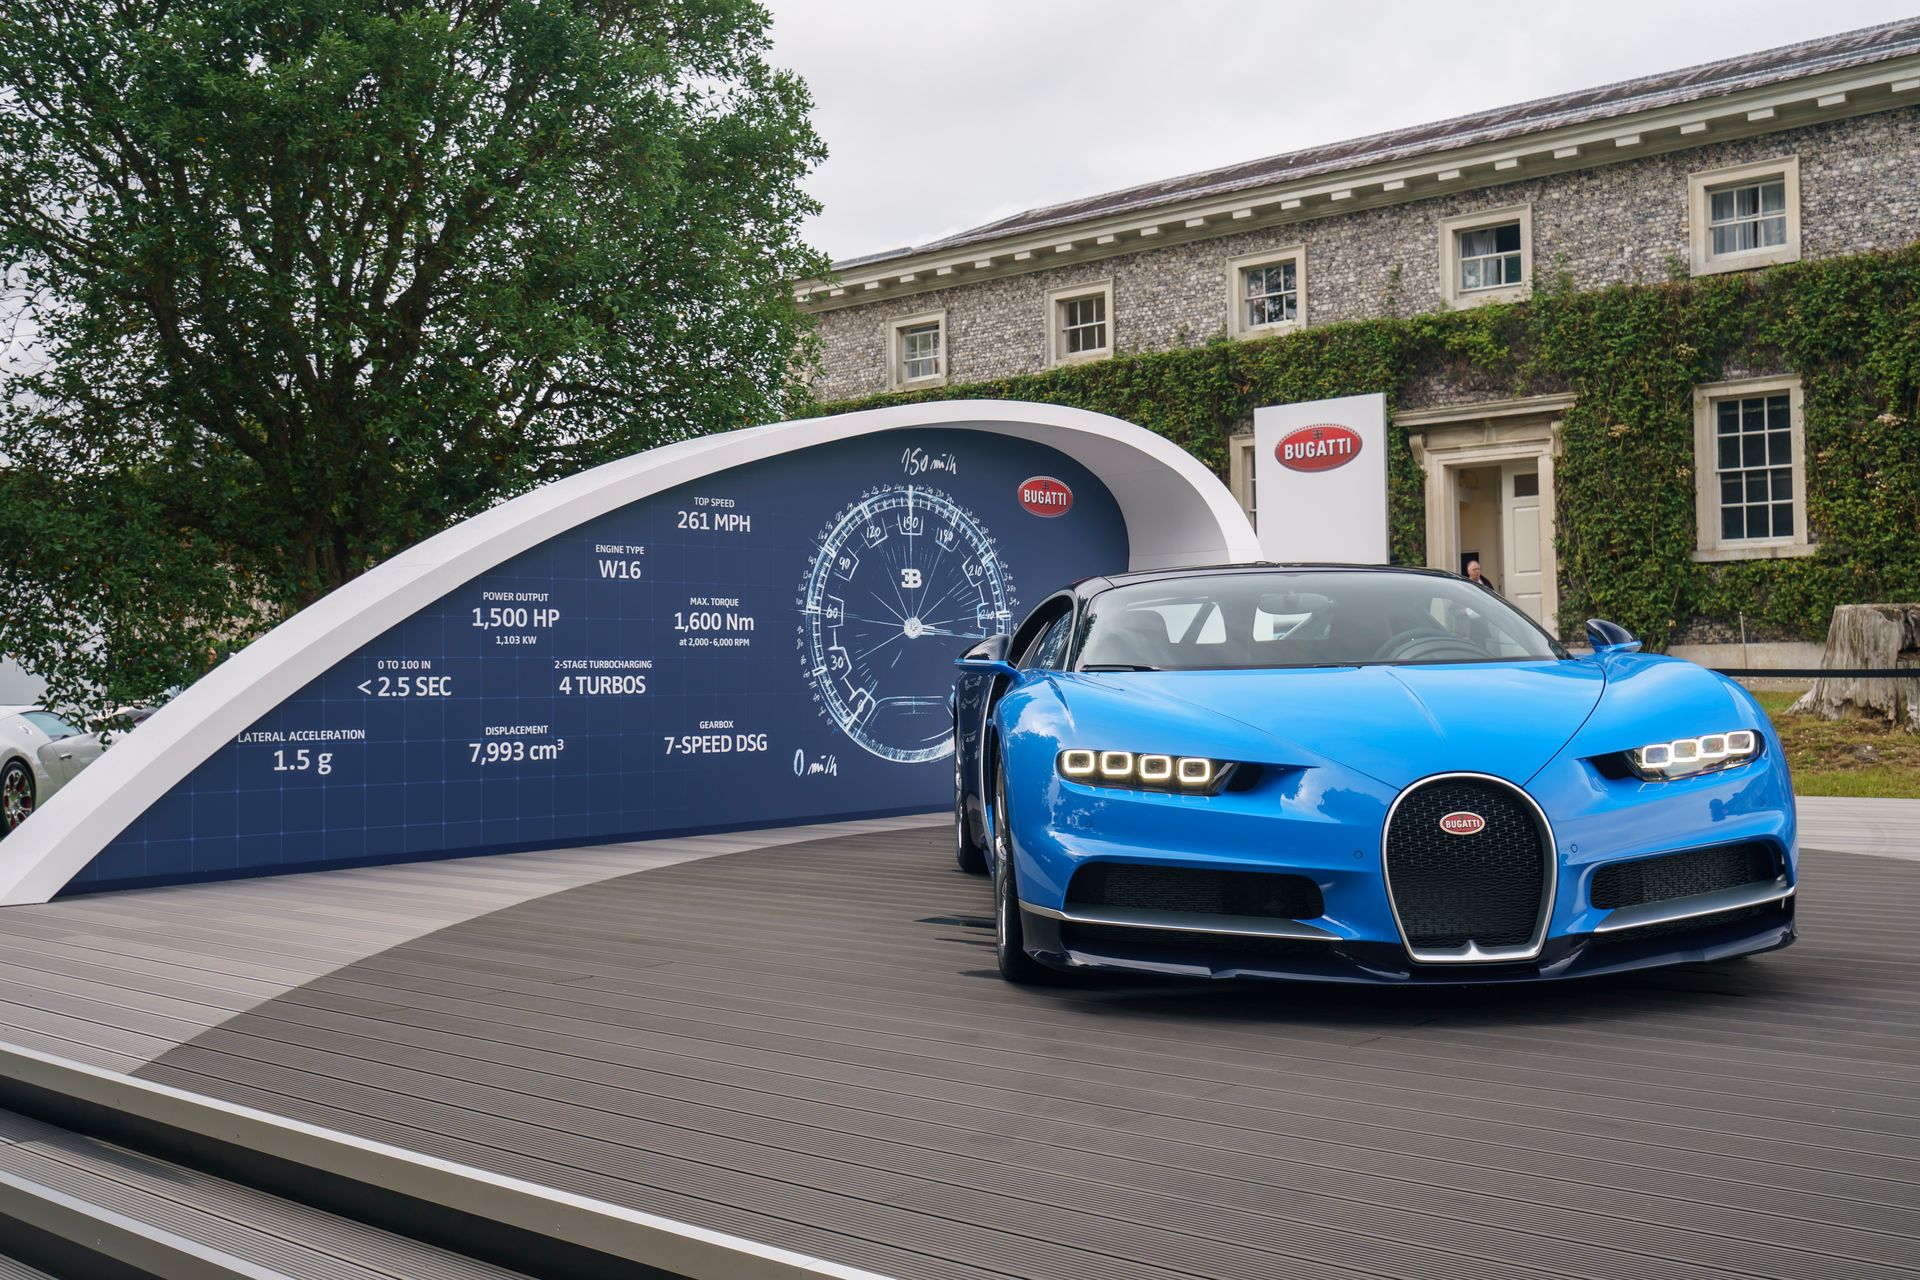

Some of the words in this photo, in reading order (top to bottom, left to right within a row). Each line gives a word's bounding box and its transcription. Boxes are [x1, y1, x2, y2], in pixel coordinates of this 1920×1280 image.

[1284, 437, 1351, 460] BUGATTI
[901, 447, 928, 476] 150
[693, 496, 710, 507] TOP
[710, 497, 735, 508] SPEED
[1024, 489, 1067, 506] BUGATTI
[677, 510, 711, 531] 261
[714, 512, 751, 533] MPH
[866, 525, 881, 538] 120
[595, 544, 625, 554] ENGINE
[625, 545, 645, 555] TYPE
[598, 559, 642, 580] W16
[839, 556, 851, 570] 90
[968, 564, 983, 576] 210
[482, 591, 515, 601] POWER
[515, 592, 550, 602] OUTPUT
[690, 597, 710, 606] MAX.
[710, 597, 740, 609] TORQUE
[826, 603, 839, 619] 60
[979, 609, 995, 619] 240
[472, 607, 528, 630] 1,500
[533, 608, 560, 628] HP
[674, 611, 722, 633] 1,600
[726, 612, 755, 631] Nm
[495, 635, 521, 646] 1,103
[522, 635, 537, 645] KW
[678, 638, 688, 647] at
[734, 638, 750, 647] RPM
[377, 660, 385, 670] 0
[385, 660, 399, 670] TO
[400, 660, 420, 670] 100
[421, 660, 432, 670] IN
[554, 659, 588, 669] 2-STAGE
[588, 659, 653, 669] TURBOCHARGING
[830, 654, 844, 671] 30
[377, 676, 410, 697] 2.5
[415, 675, 452, 697] SEC
[558, 676, 573, 695] 4
[575, 675, 647, 695] TURBOS
[485, 724, 549, 736] DISPLACEMENT
[699, 720, 734, 730] GEARBOX
[238, 731, 286, 743] LATERAL
[288, 729, 366, 742] ACCELERATION
[663, 734, 733, 755] 7-SPEED
[736, 733, 768, 753] DSG
[468, 741, 525, 766] 7,993
[273, 749, 310, 771] 1.5
[317, 752, 333, 776] g
[793, 748, 805, 776] 0
[1445, 819, 1480, 829] BUGATTI
